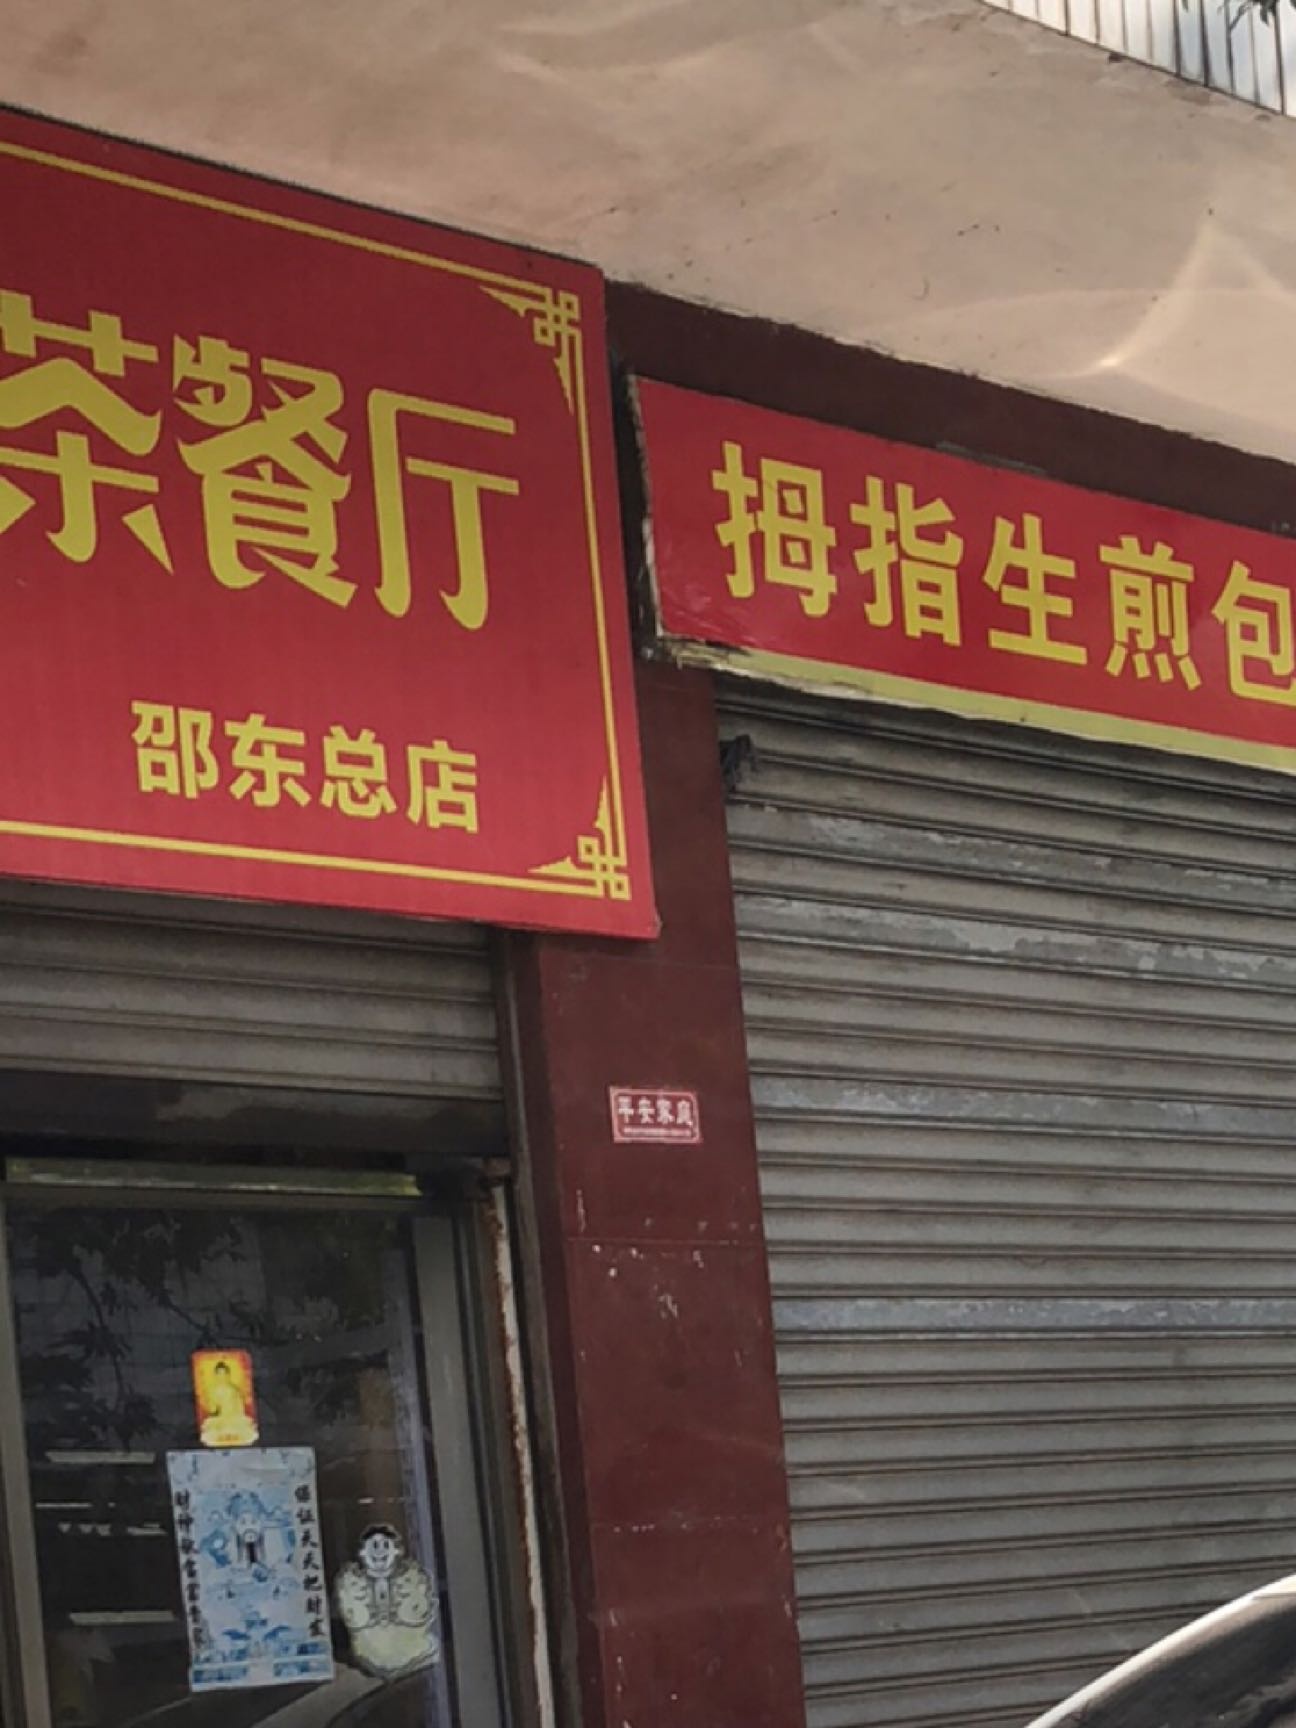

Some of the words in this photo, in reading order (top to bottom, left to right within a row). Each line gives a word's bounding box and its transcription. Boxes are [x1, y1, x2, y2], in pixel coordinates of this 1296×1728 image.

[0, 288, 520, 631] 茶餐厅
[130, 700, 480, 834] 邵东总店
